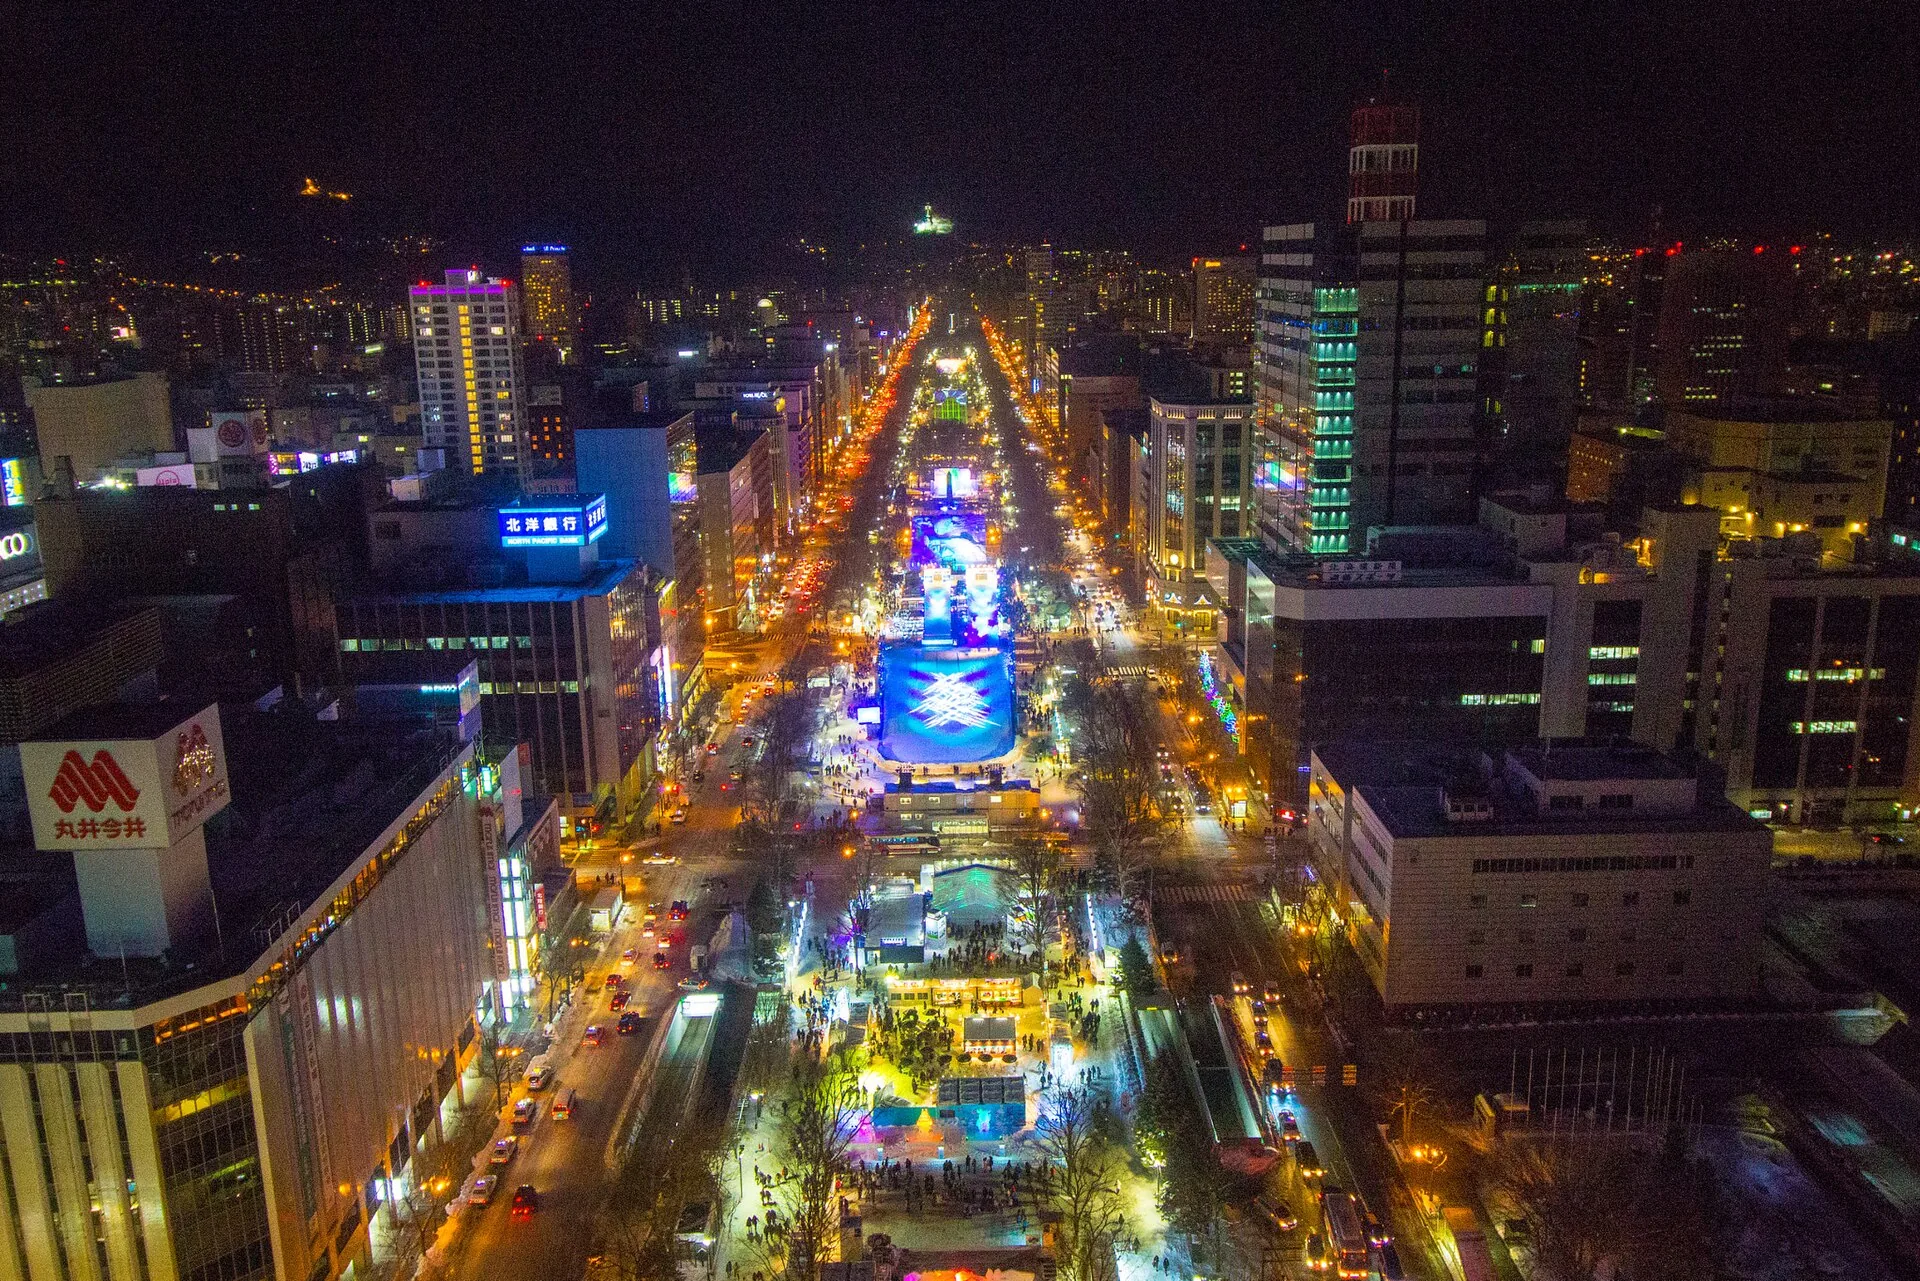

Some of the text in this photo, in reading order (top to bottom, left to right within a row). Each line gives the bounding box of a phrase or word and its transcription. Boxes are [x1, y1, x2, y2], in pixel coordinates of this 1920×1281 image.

[506, 516, 577, 532] 北洋銀行
[55, 817, 146, 840] 丸井今井
